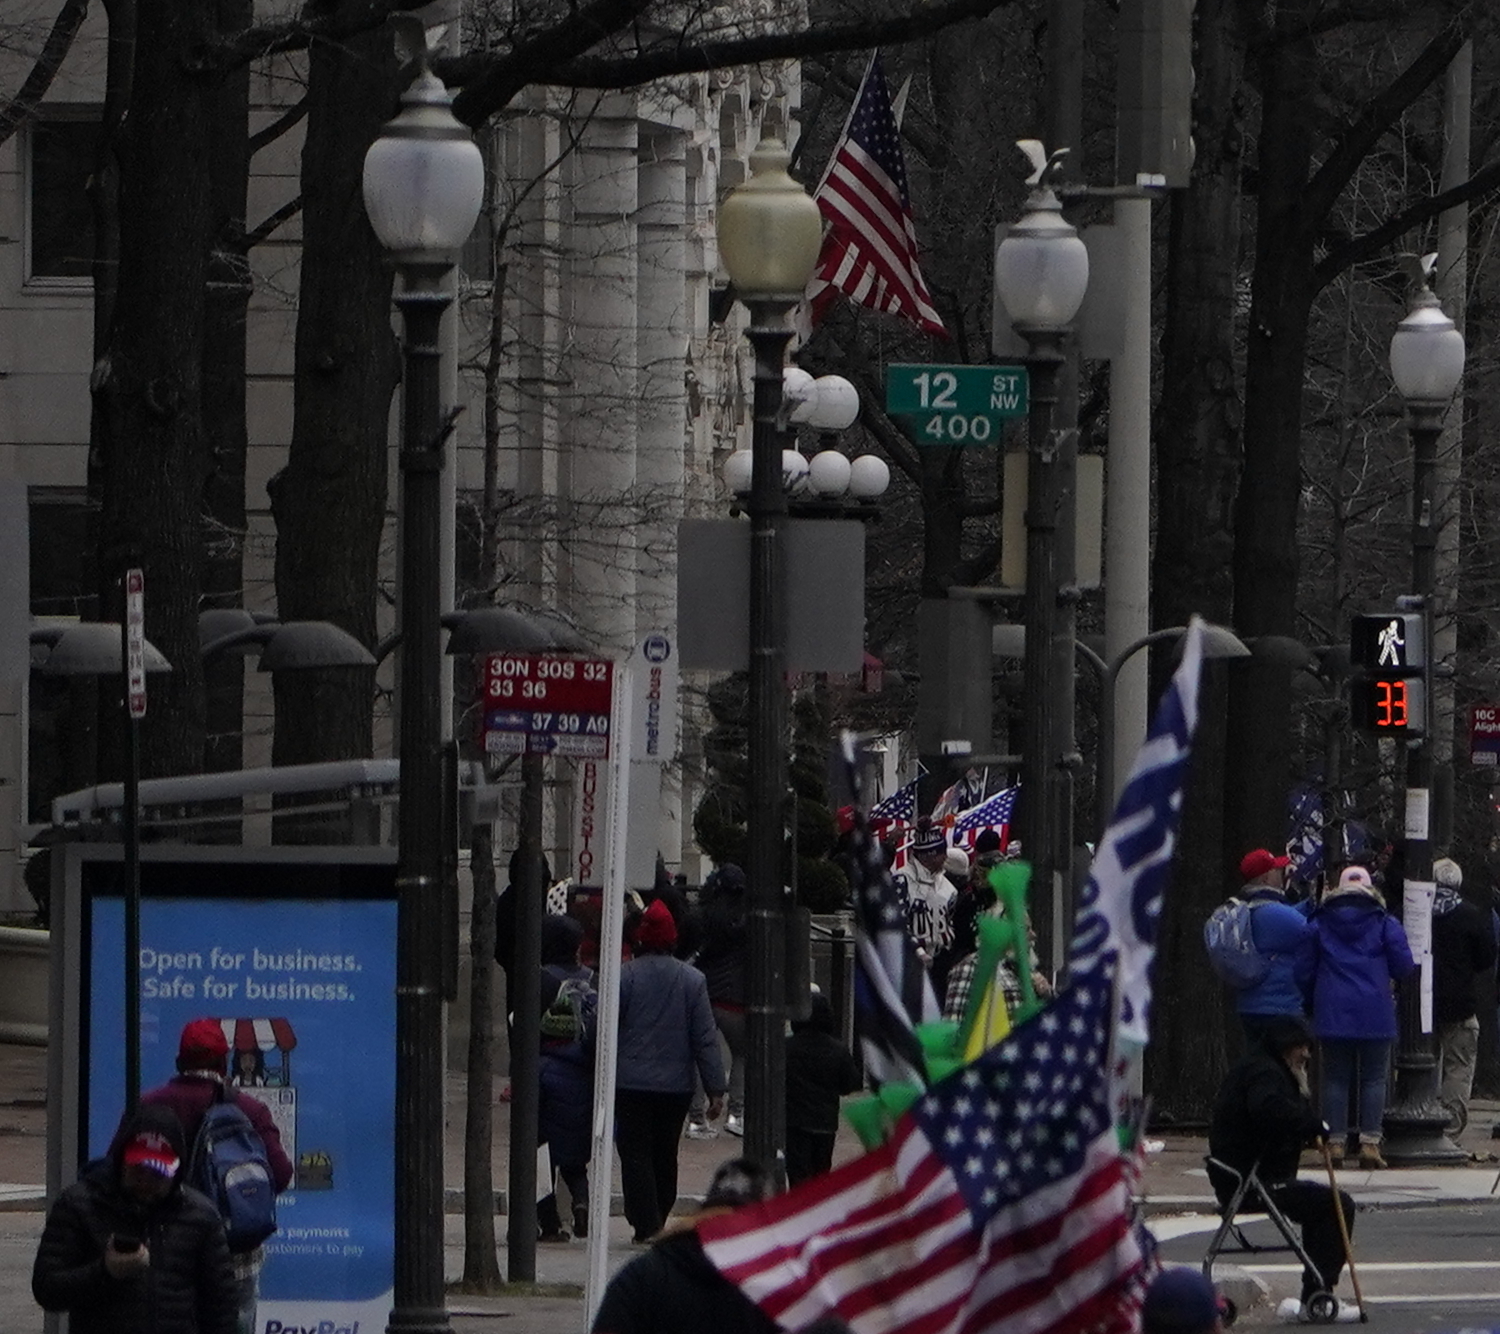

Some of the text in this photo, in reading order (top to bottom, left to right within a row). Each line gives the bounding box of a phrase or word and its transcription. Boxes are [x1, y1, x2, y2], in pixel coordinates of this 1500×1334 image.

[912, 371, 1019, 408] 12 ST
[990, 393, 1019, 410] NW
[925, 414, 991, 441] 400
[490, 658, 607, 682] 30N 30S 32
[489, 680, 547, 699] 33 36
[1376, 680, 1409, 727] 33
[532, 713, 552, 731] 37
[582, 762, 597, 813] BUS
[578, 816, 596, 885] STOP
[139, 946, 363, 976] Open for business.
[143, 974, 356, 1002] Safe for business.
[287, 1226, 350, 1242] payments
[265, 1243, 323, 1256] ustomers
